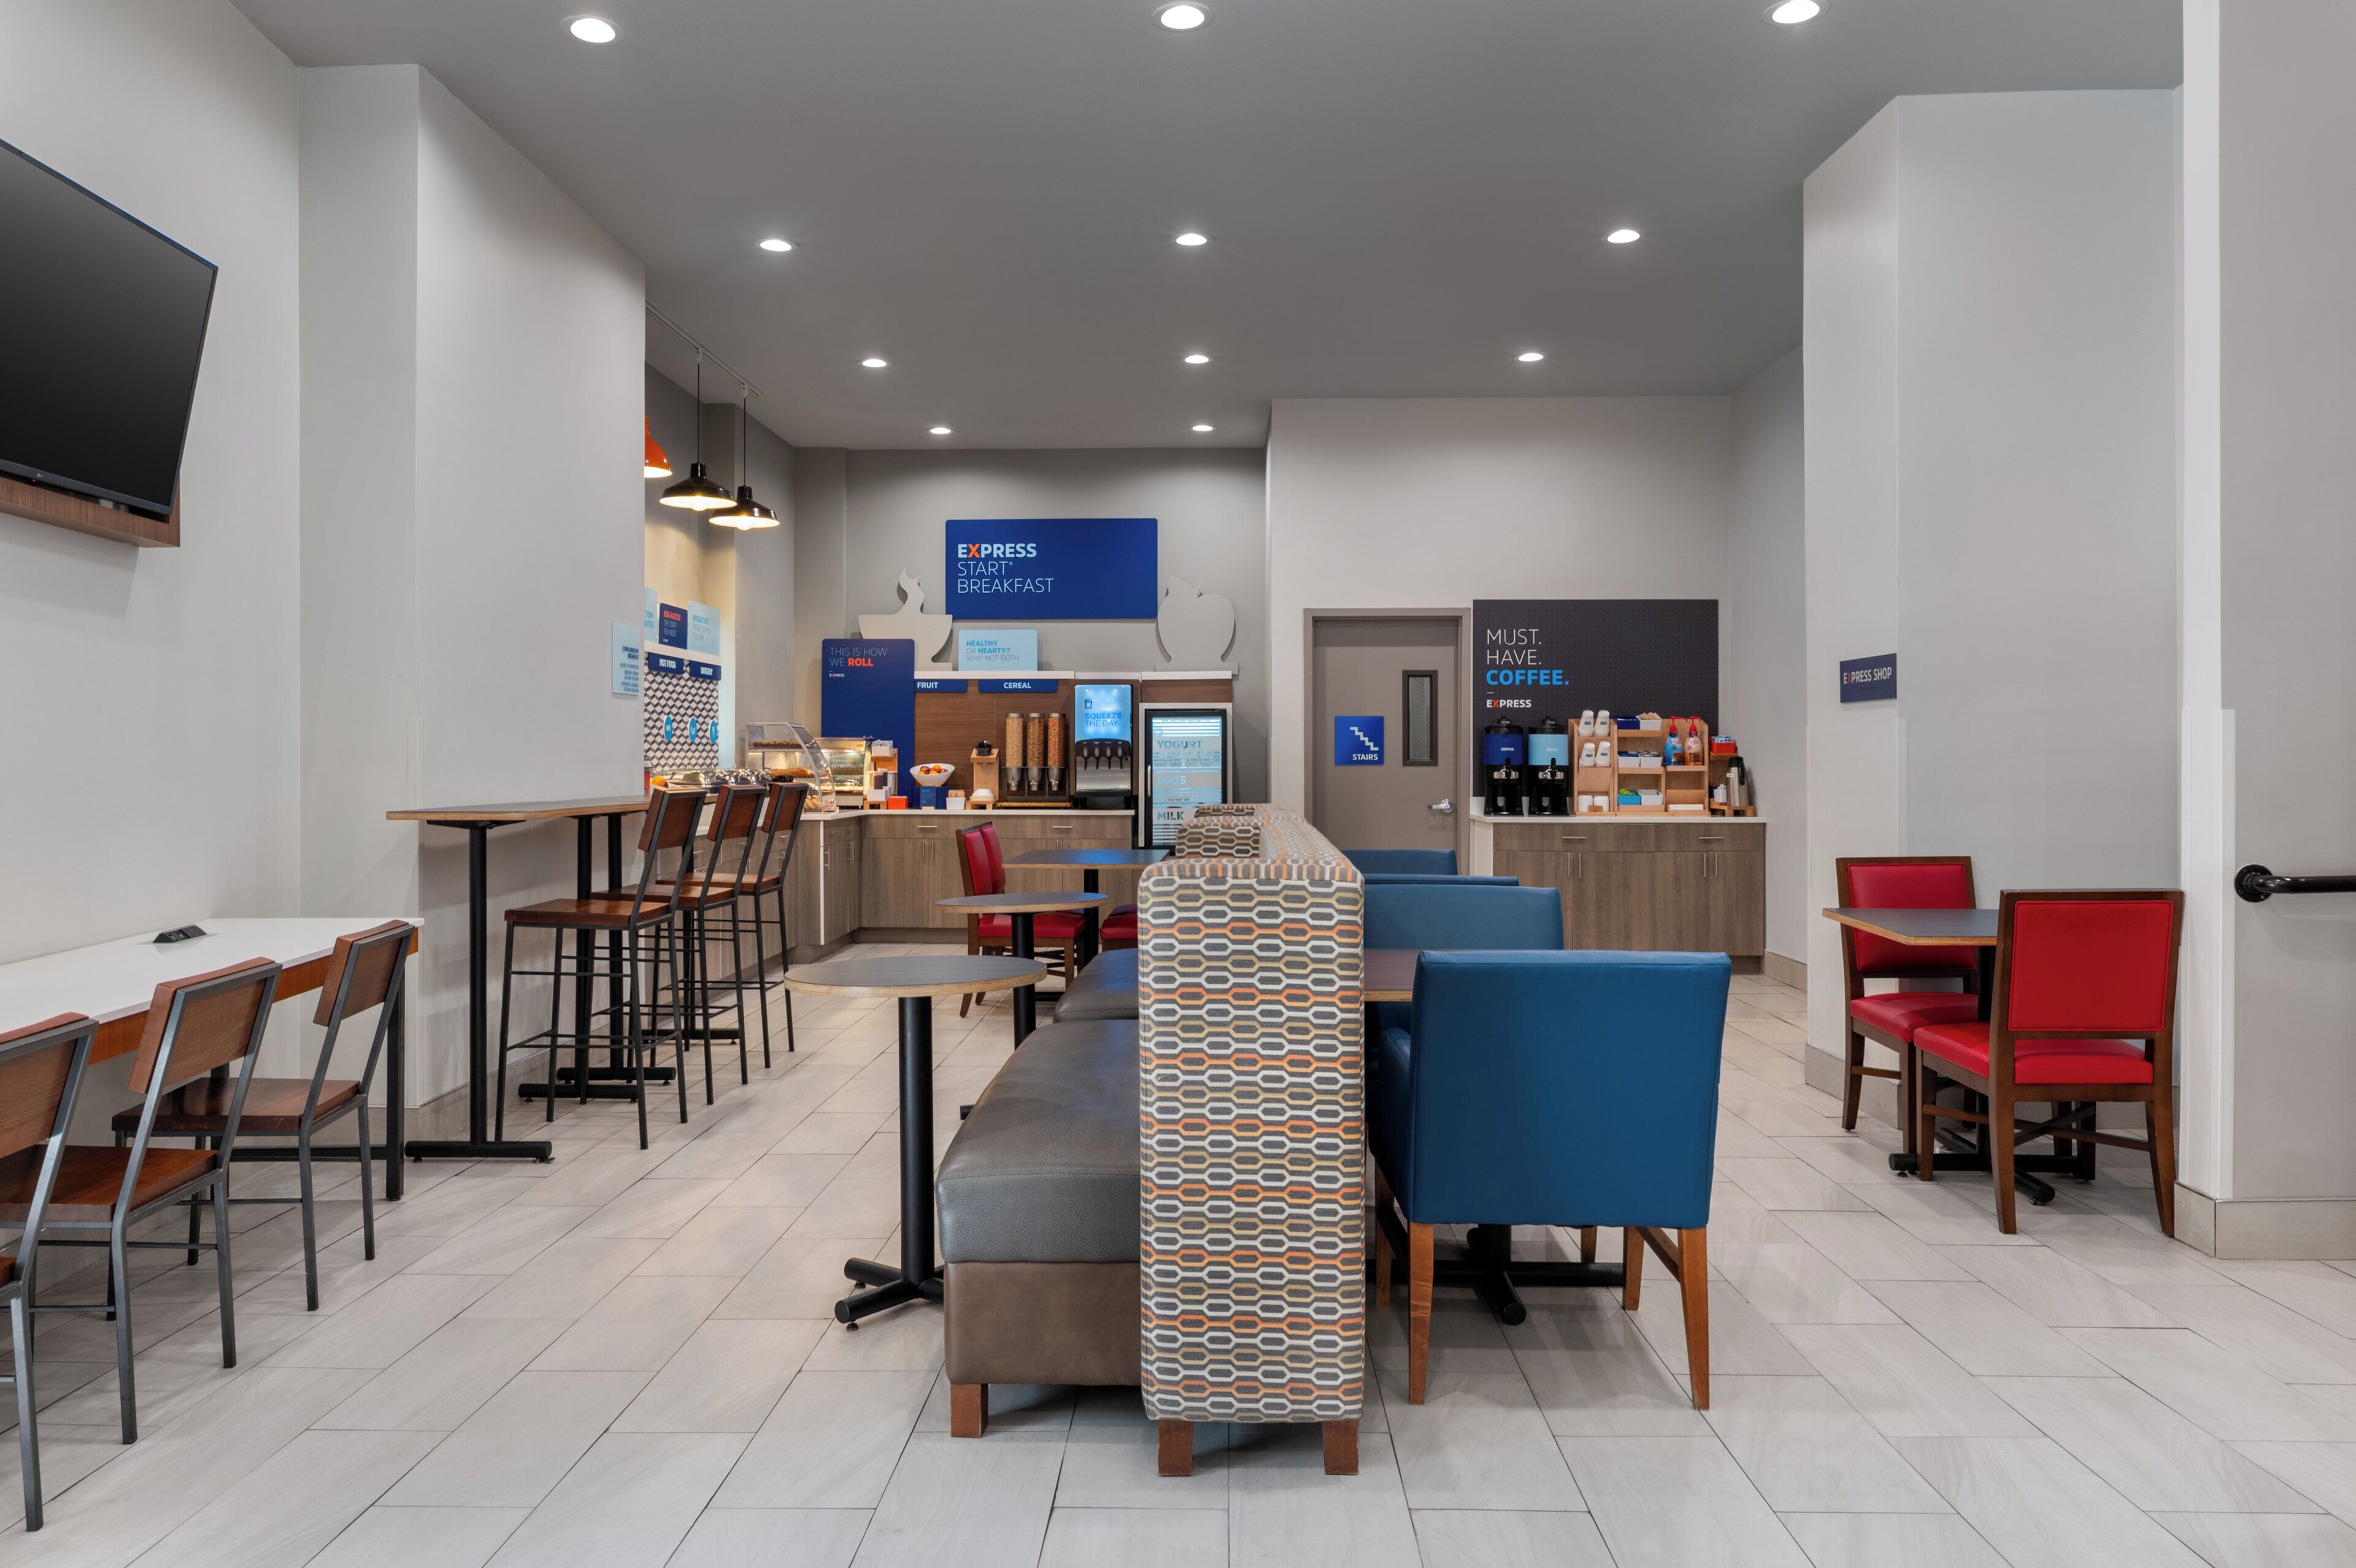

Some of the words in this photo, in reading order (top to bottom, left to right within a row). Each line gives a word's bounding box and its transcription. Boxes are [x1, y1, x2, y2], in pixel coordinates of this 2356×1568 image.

[958, 544, 1037, 558] EXPRESS
[958, 561, 1008, 575] START
[958, 578, 1054, 593] BREAKFAST
[1487, 629, 1542, 645] MUST.
[830, 647, 850, 656] THIS
[853, 647, 860, 656] IS
[864, 647, 888, 656] HOW
[1487, 650, 1542, 665] HAVE.
[830, 658, 845, 666] WE
[848, 658, 874, 667] ROLL
[1486, 669, 1569, 685] COFFEE.
[1843, 669, 1872, 684] EXPRESS
[1873, 667, 1892, 681] SHOP
[1487, 699, 1532, 708] EXPRESS
[1157, 775, 1187, 785] EGGS
[1157, 811, 1184, 820] MILK
